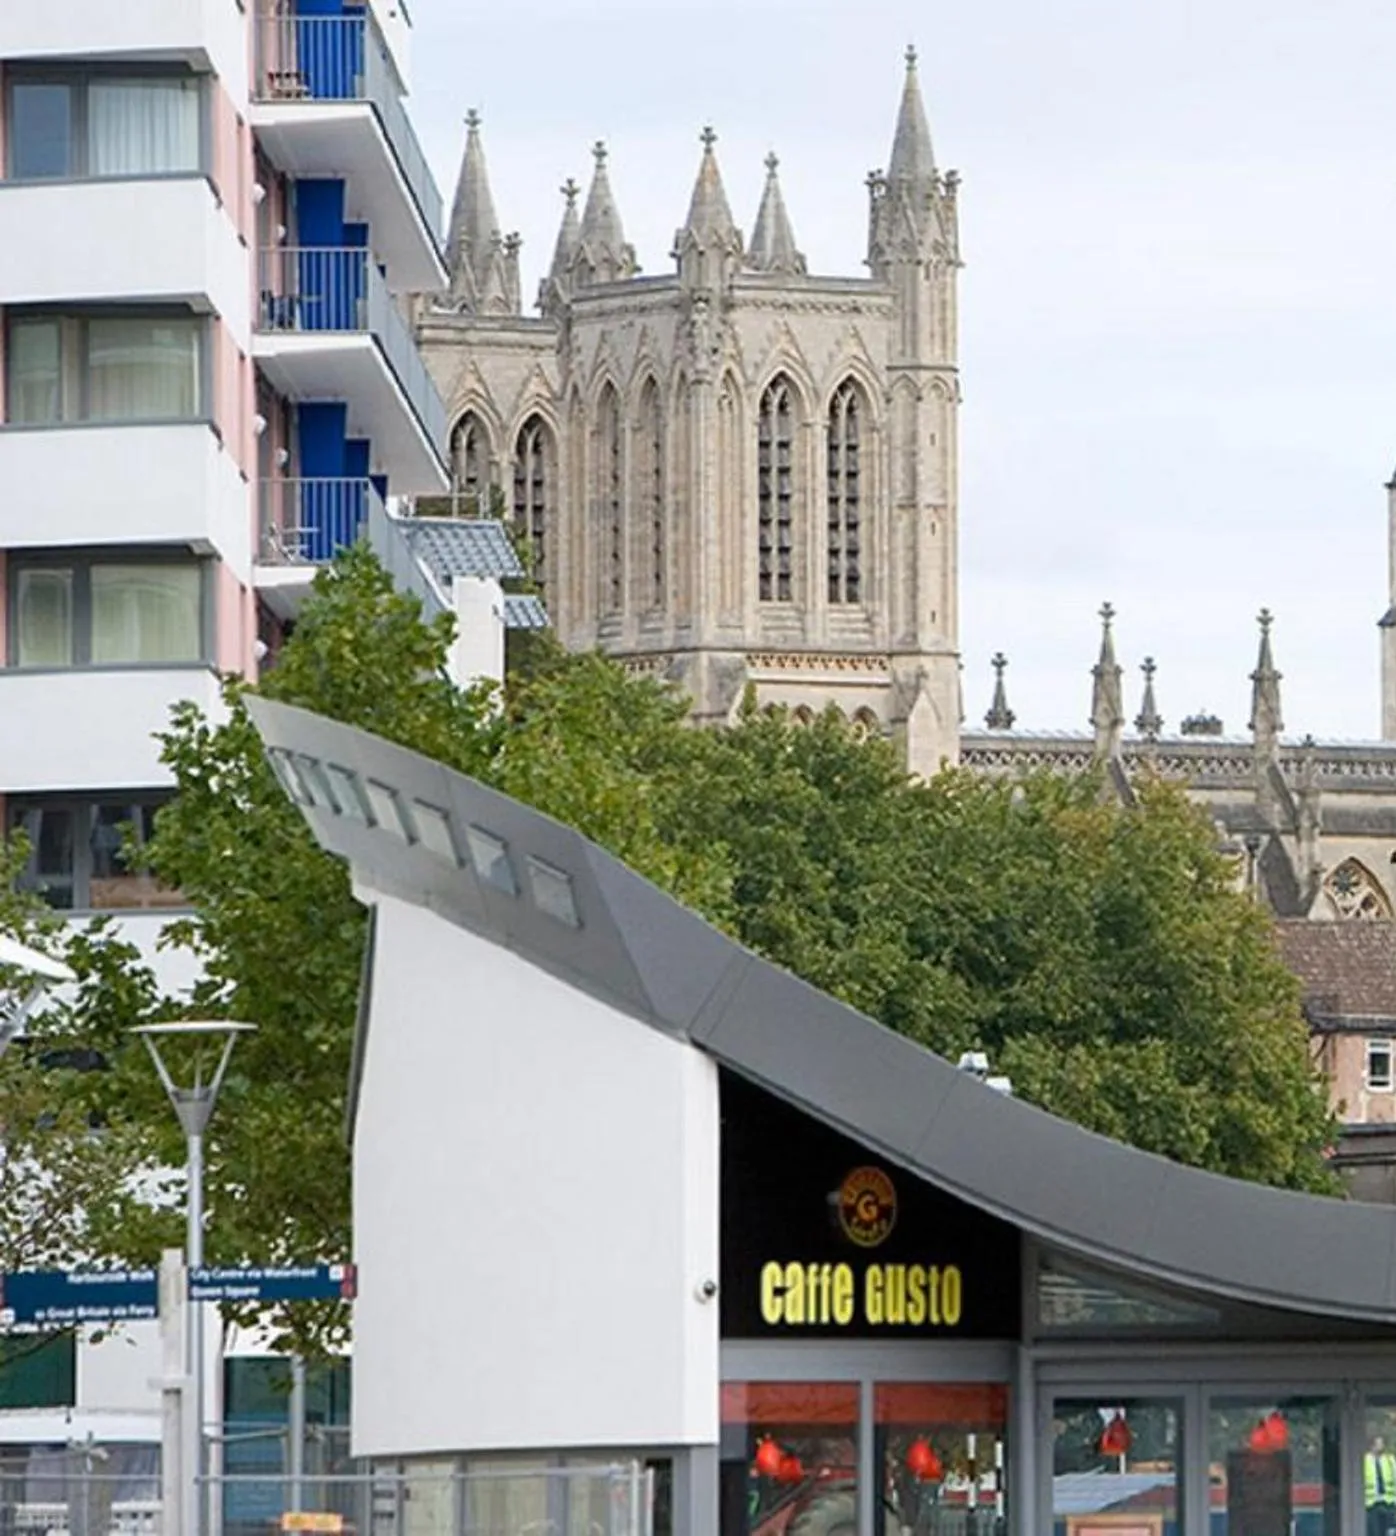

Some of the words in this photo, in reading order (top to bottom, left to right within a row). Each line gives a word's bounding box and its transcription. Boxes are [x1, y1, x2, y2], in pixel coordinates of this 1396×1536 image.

[191, 1268, 210, 1282] City
[211, 1267, 245, 1279] Centre
[263, 1267, 318, 1279] Waterfront
[224, 1285, 261, 1300] Square
[46, 1307, 75, 1319] Great
[77, 1305, 110, 1318] Britain
[128, 1304, 156, 1318] Ferry
